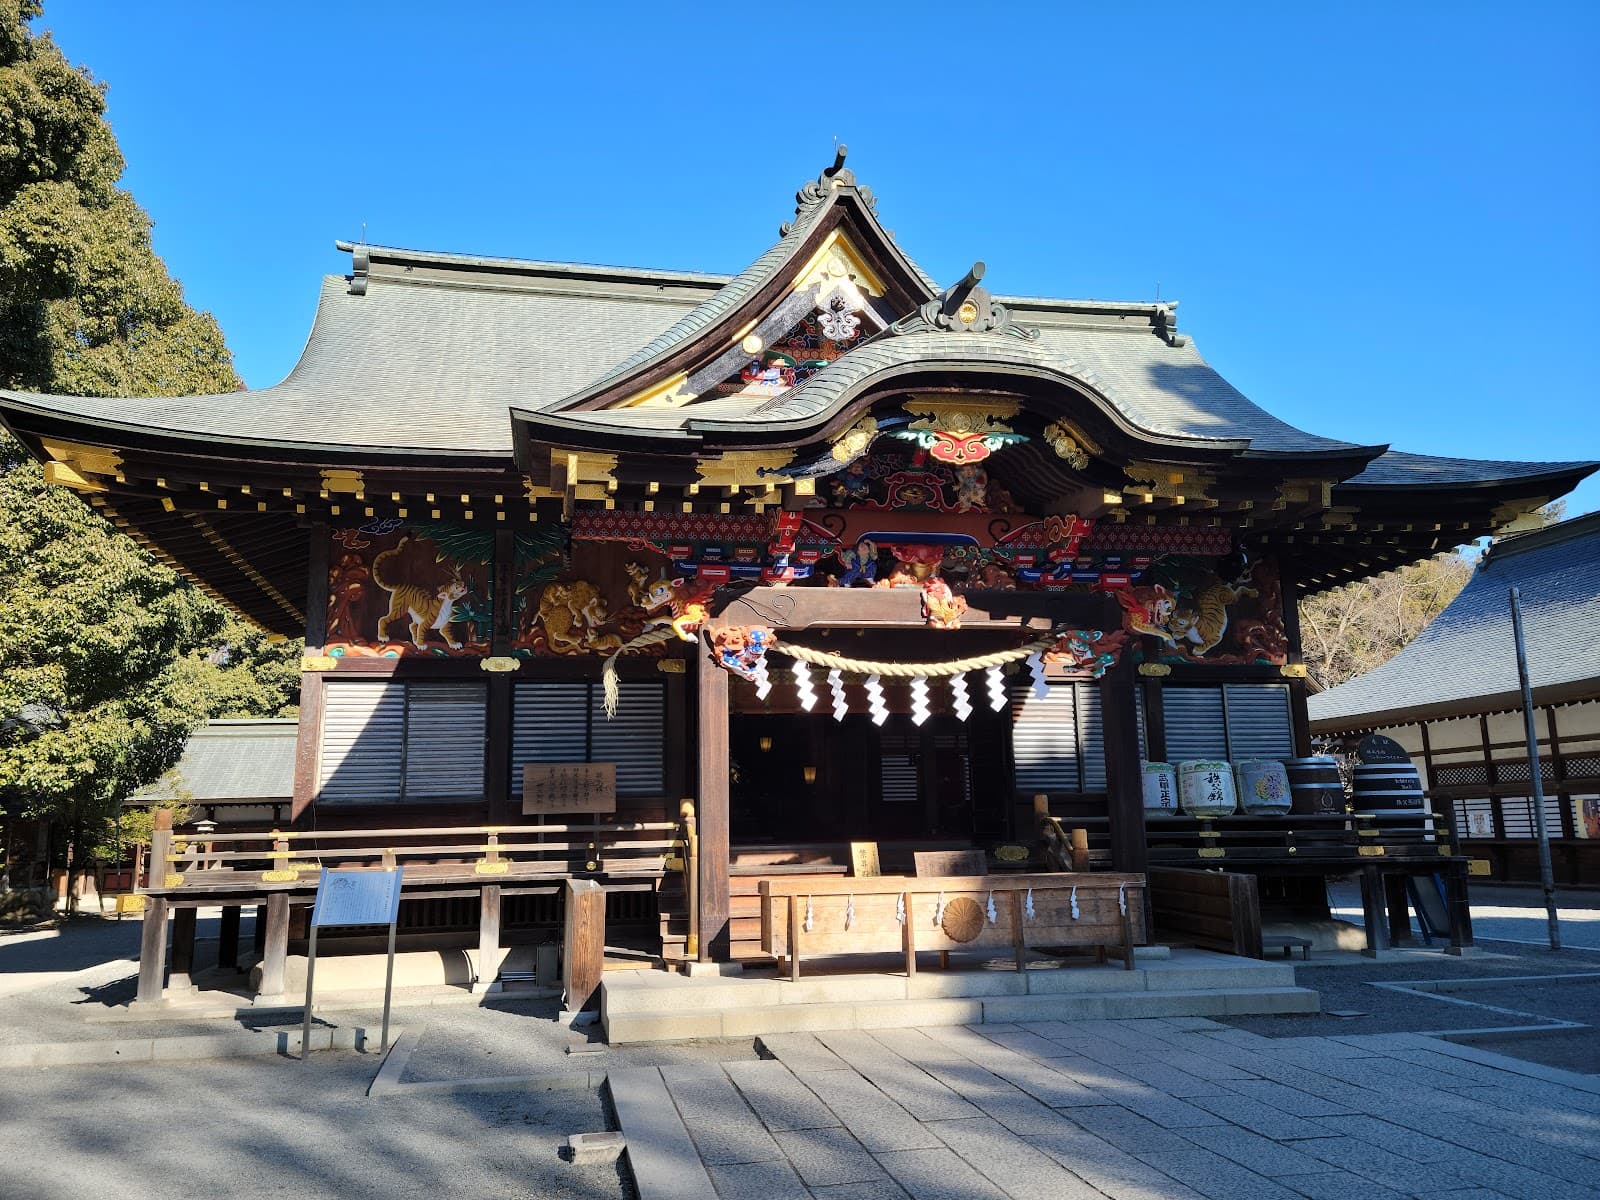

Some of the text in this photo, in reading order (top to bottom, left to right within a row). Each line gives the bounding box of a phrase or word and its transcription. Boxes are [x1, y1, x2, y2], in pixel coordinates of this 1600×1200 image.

[1158, 773, 1171, 808] 武甲正宗
[1203, 772, 1224, 808] 秩父錦
